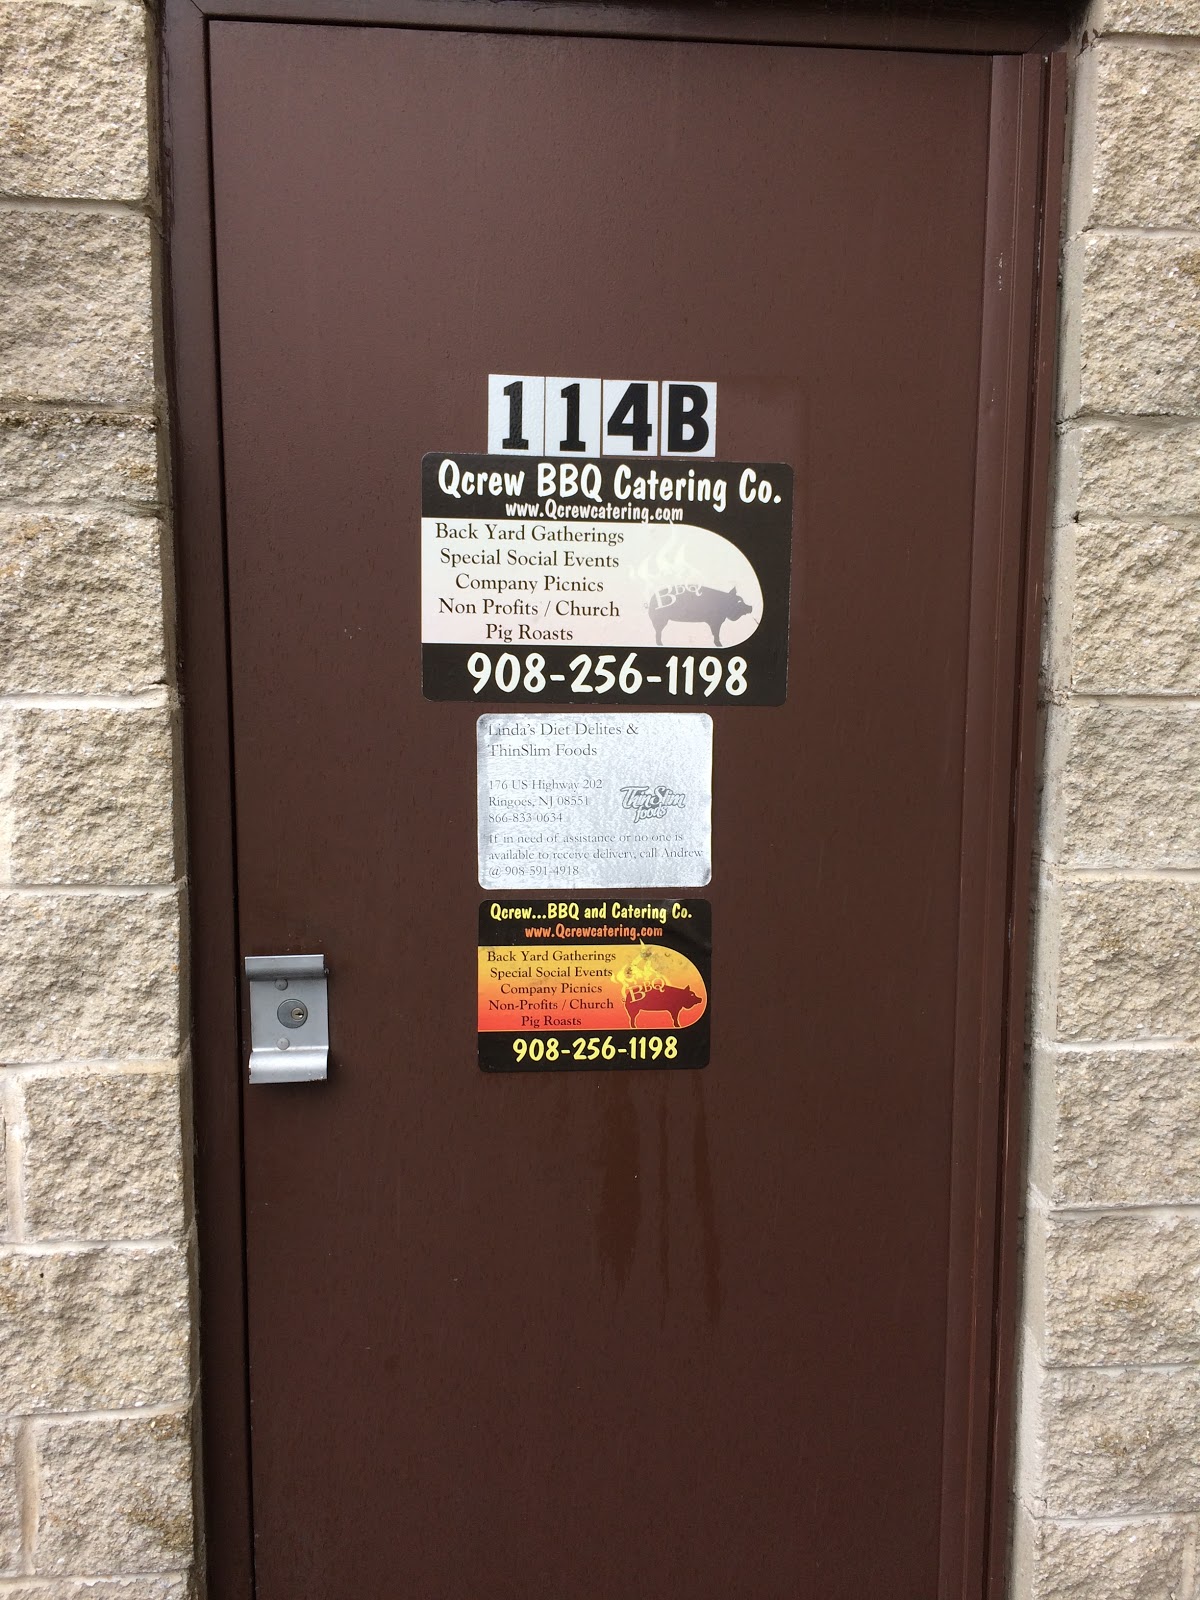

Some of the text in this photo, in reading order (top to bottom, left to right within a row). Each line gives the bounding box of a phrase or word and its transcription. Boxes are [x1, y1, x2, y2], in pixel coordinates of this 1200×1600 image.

[502, 381, 709, 453] 114B
[438, 459, 782, 512] Qcrew BBQ Catering Co.
[505, 498, 683, 524] www.Qcrewcatering.com
[435, 523, 624, 546] Back Yard Gatherings
[440, 548, 620, 568] Special Social Events
[455, 573, 604, 594] Company Picnics
[438, 598, 477, 615] Non
[482, 598, 539, 616] Profits
[555, 600, 620, 617] Church
[485, 624, 573, 643] Pig Roasts
[467, 651, 748, 697] 908-256-1198
[487, 722, 639, 736] Linda's Diet Delites &
[487, 744, 598, 757] ThinSlim Foods
[489, 779, 603, 792] 176 US Highway 202
[539, 796, 554, 809] NJ
[557, 796, 589, 806] 08551
[620, 785, 686, 809] ThinSlim
[488, 812, 563, 823] 866-833-0634
[488, 833, 683, 844] If in need of assistance or no one is
[488, 847, 703, 861] available to receive delivery, call Andrew
[488, 865, 579, 877] @ 908-591-4918
[584, 903, 606, 919] and
[611, 904, 667, 924] Catering
[672, 903, 692, 919] Co.
[525, 923, 663, 941] www.Qcrewcatering.com
[487, 950, 617, 964] Back Yard Gatherings
[490, 966, 613, 980] Special Social Events
[500, 982, 603, 996] Company Picnics
[629, 977, 666, 1003] BBQ
[489, 1000, 558, 1011] Non-Profits
[569, 998, 614, 1009] Church
[521, 1015, 582, 1028] Pig Roasts
[513, 1035, 678, 1062] 908-256-1198
